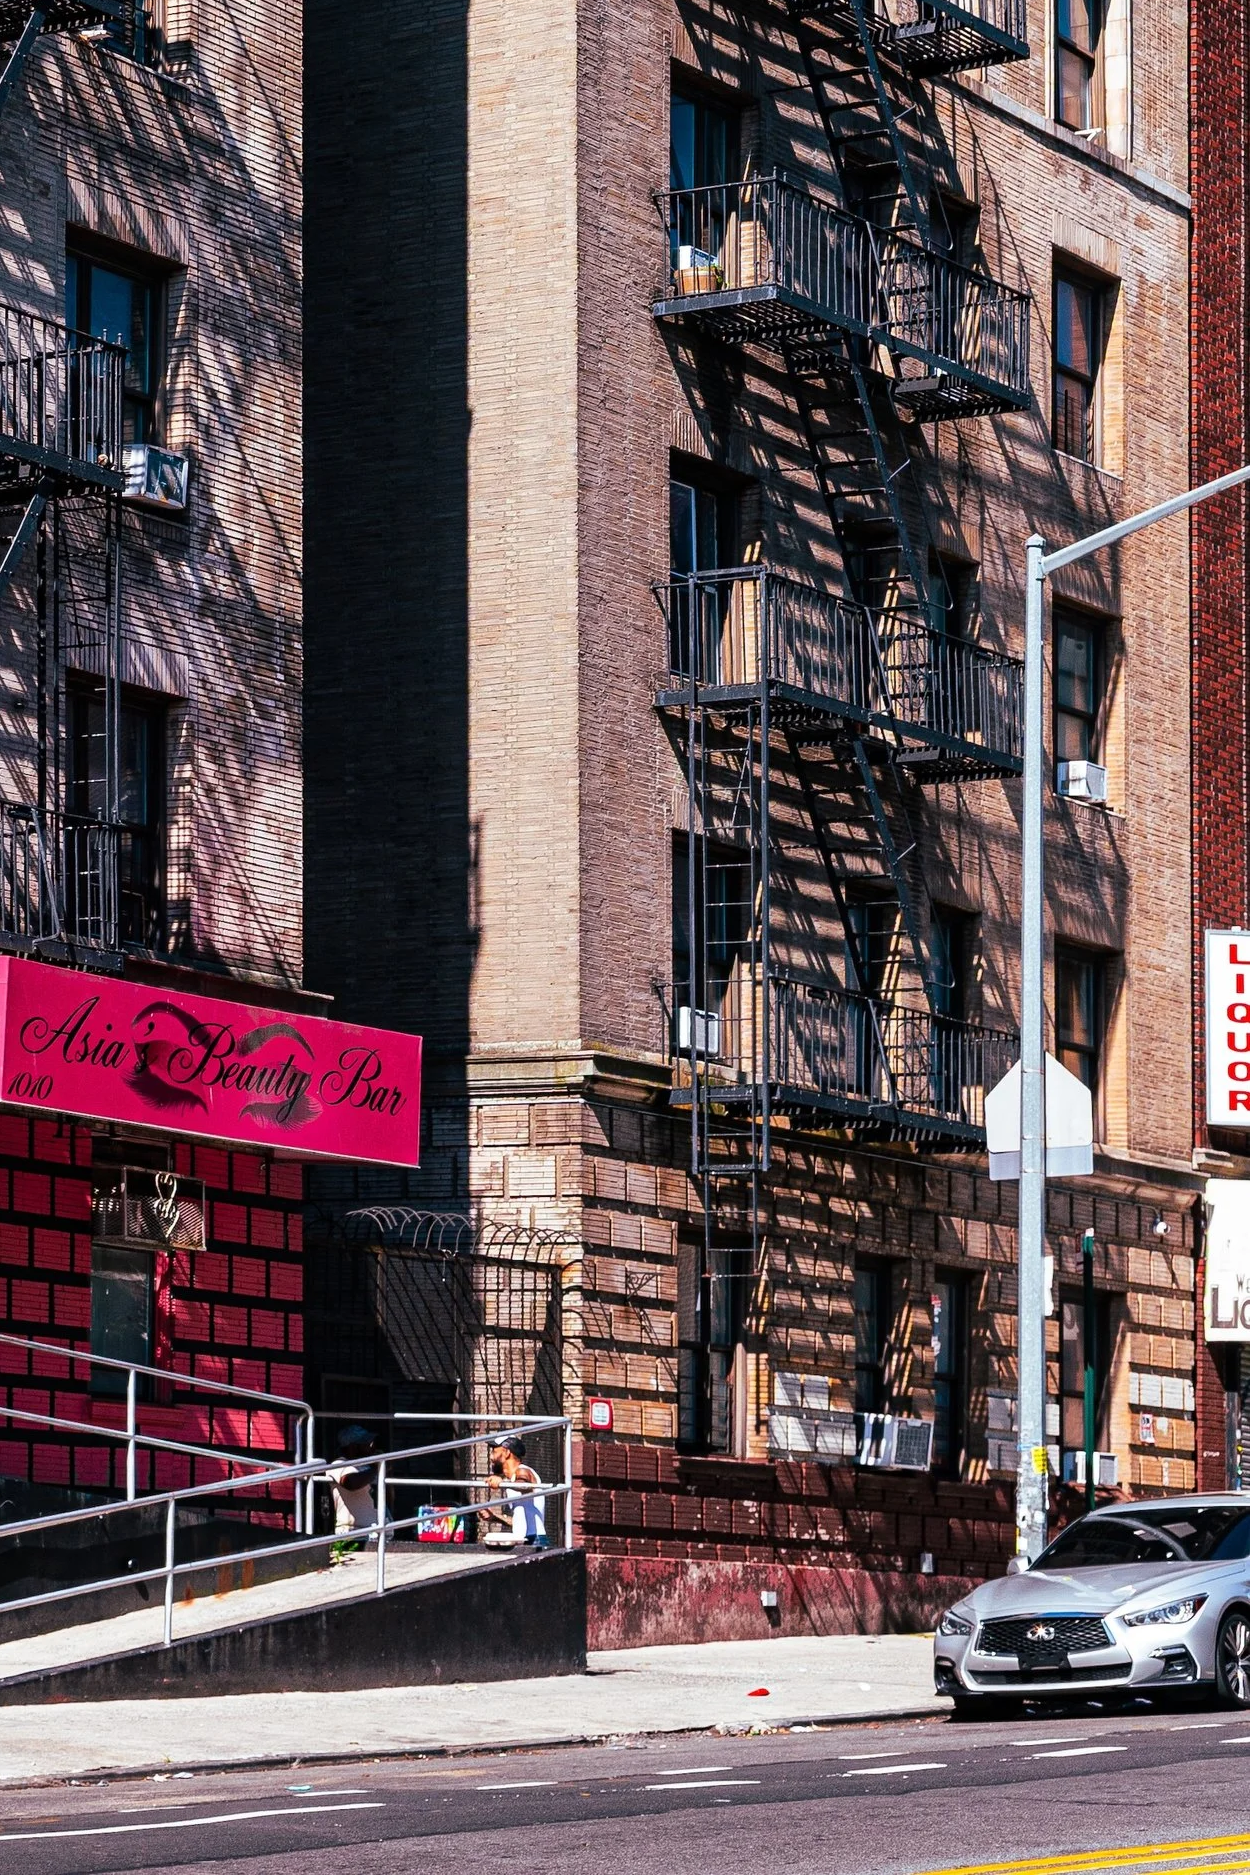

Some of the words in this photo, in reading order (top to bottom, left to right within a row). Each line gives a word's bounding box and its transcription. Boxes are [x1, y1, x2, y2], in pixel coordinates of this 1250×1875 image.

[7, 1071, 54, 1101] 1010
[20, 996, 159, 1074] Asia's
[166, 1022, 312, 1123] Beauty
[319, 1047, 407, 1117] Bar
[1226, 943, 1250, 1112] LIQUOR
